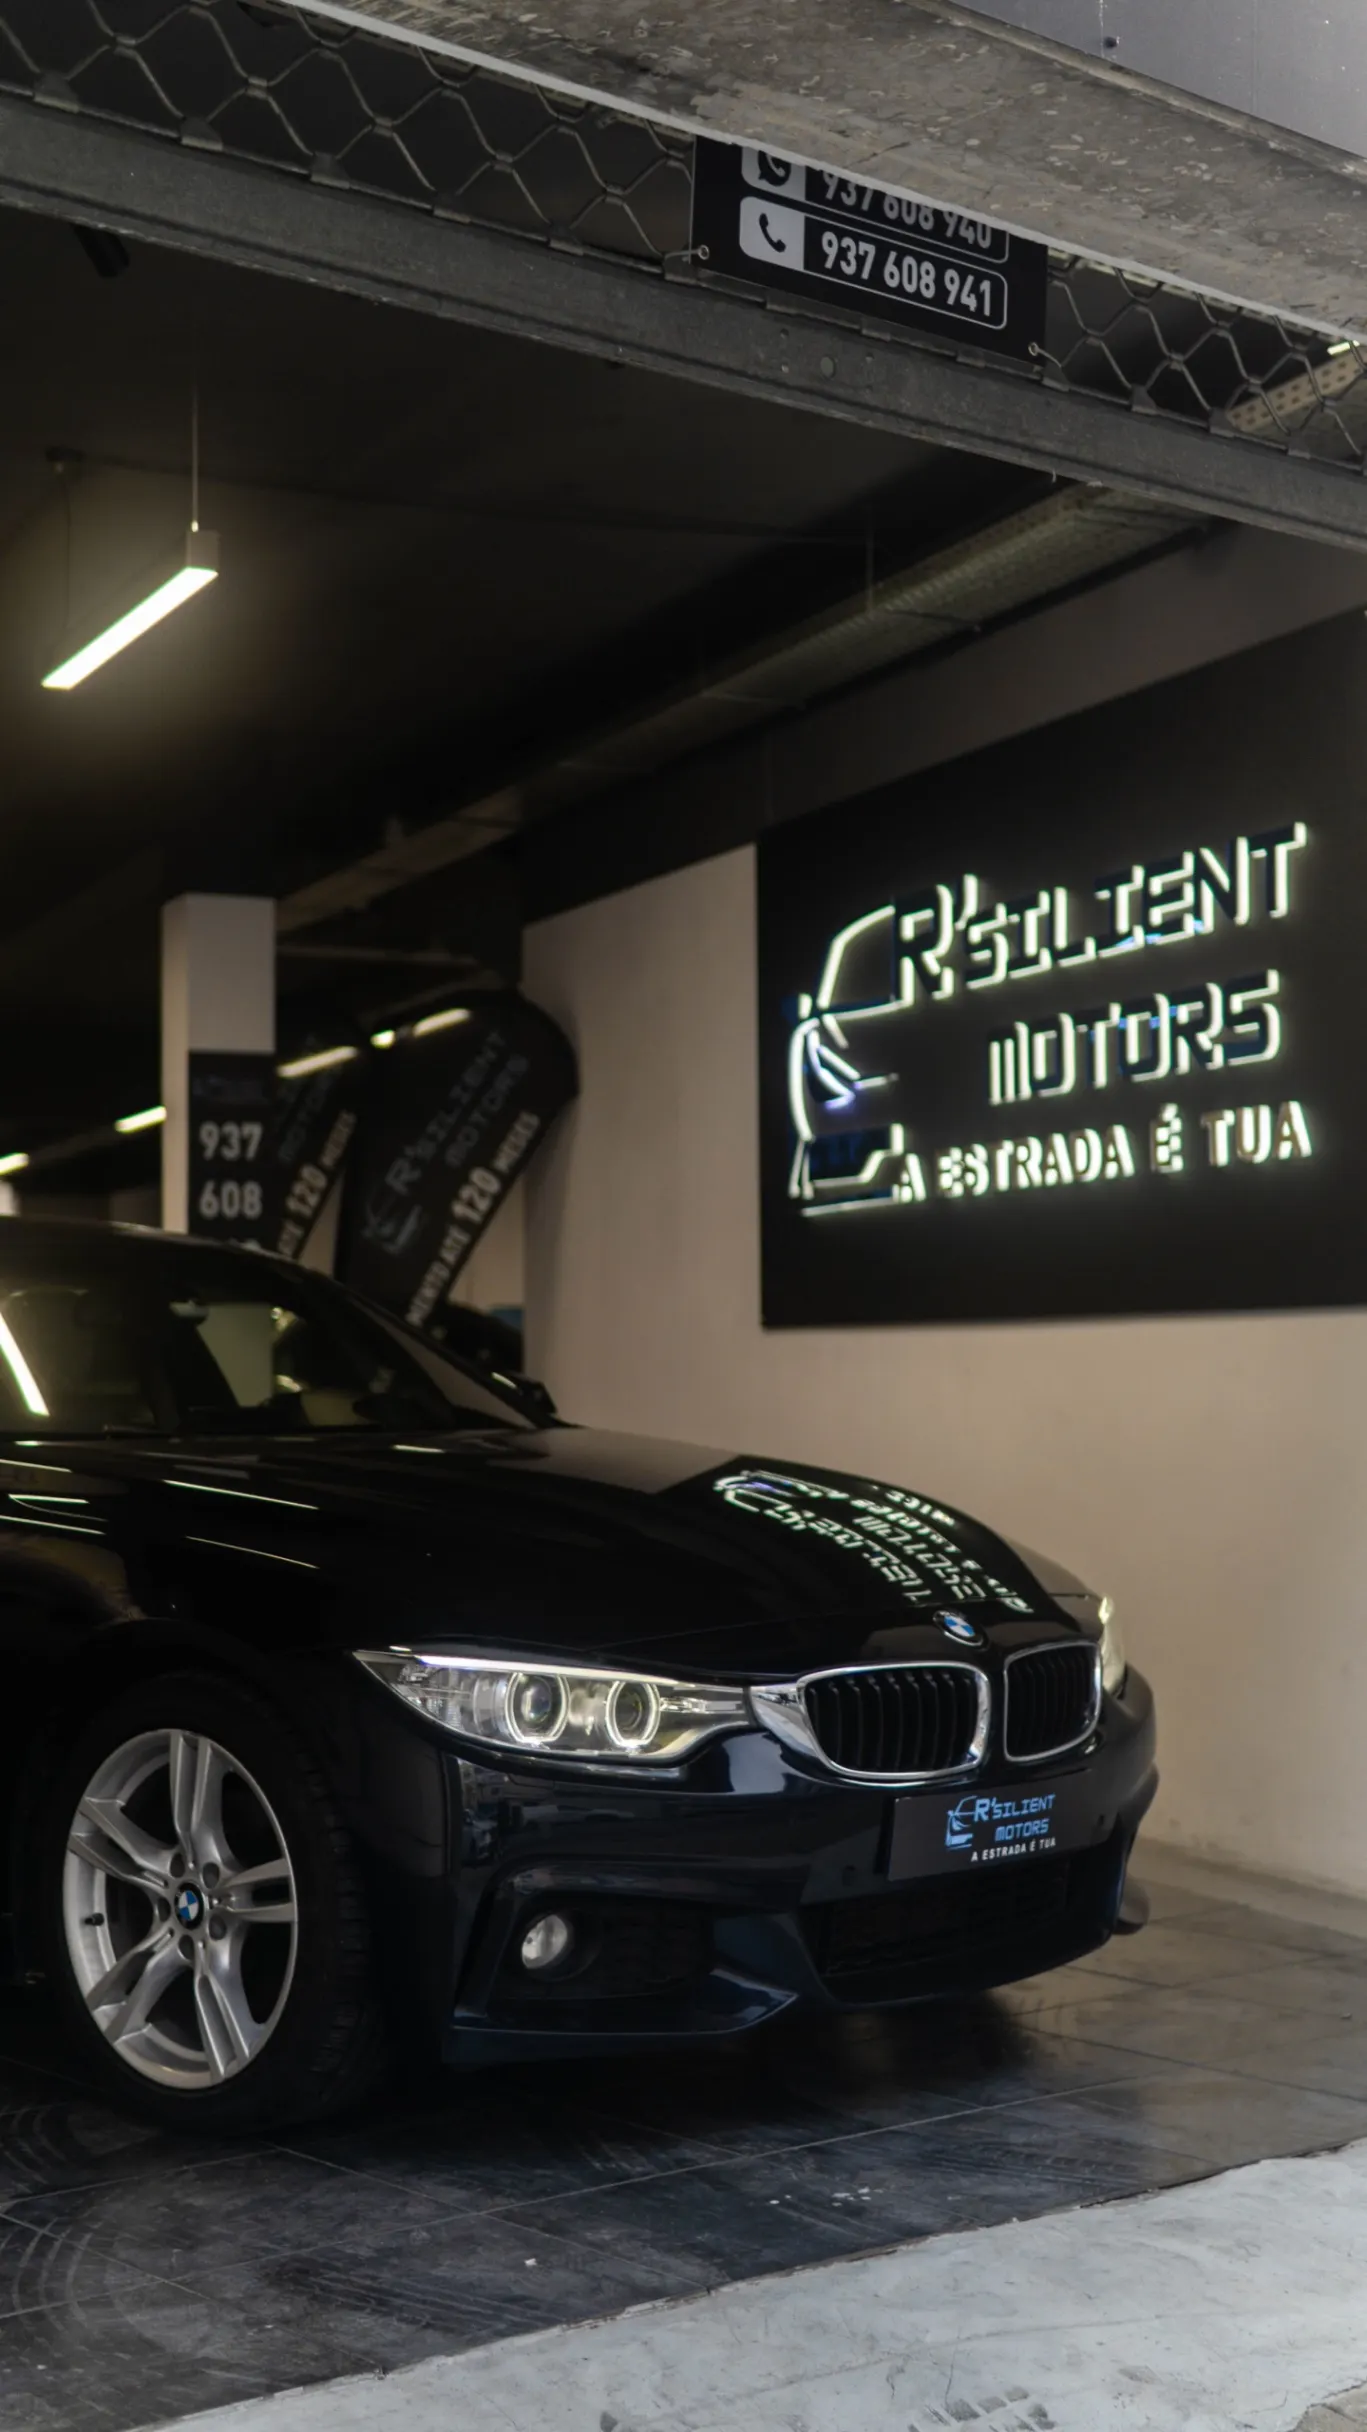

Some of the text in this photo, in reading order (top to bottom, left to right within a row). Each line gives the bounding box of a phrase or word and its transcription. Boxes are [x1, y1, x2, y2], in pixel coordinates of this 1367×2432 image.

[821, 170, 992, 249] 937 608 940
[821, 231, 991, 317] 937 608 941
[895, 822, 1308, 1000] R'SILIENT
[986, 969, 1283, 1106] MOTORS
[198, 1120, 265, 1162] 937
[893, 1099, 1314, 1203] A ESTRADA É TUA
[198, 1179, 265, 1221] 608
[285, 1163, 328, 1219] 120
[451, 1165, 502, 1226] 120
[974, 1793, 1056, 1822] R'SILIENT
[994, 1818, 1050, 1842] MOTORS
[971, 1837, 1056, 1862] A ESTRADA É TUA
